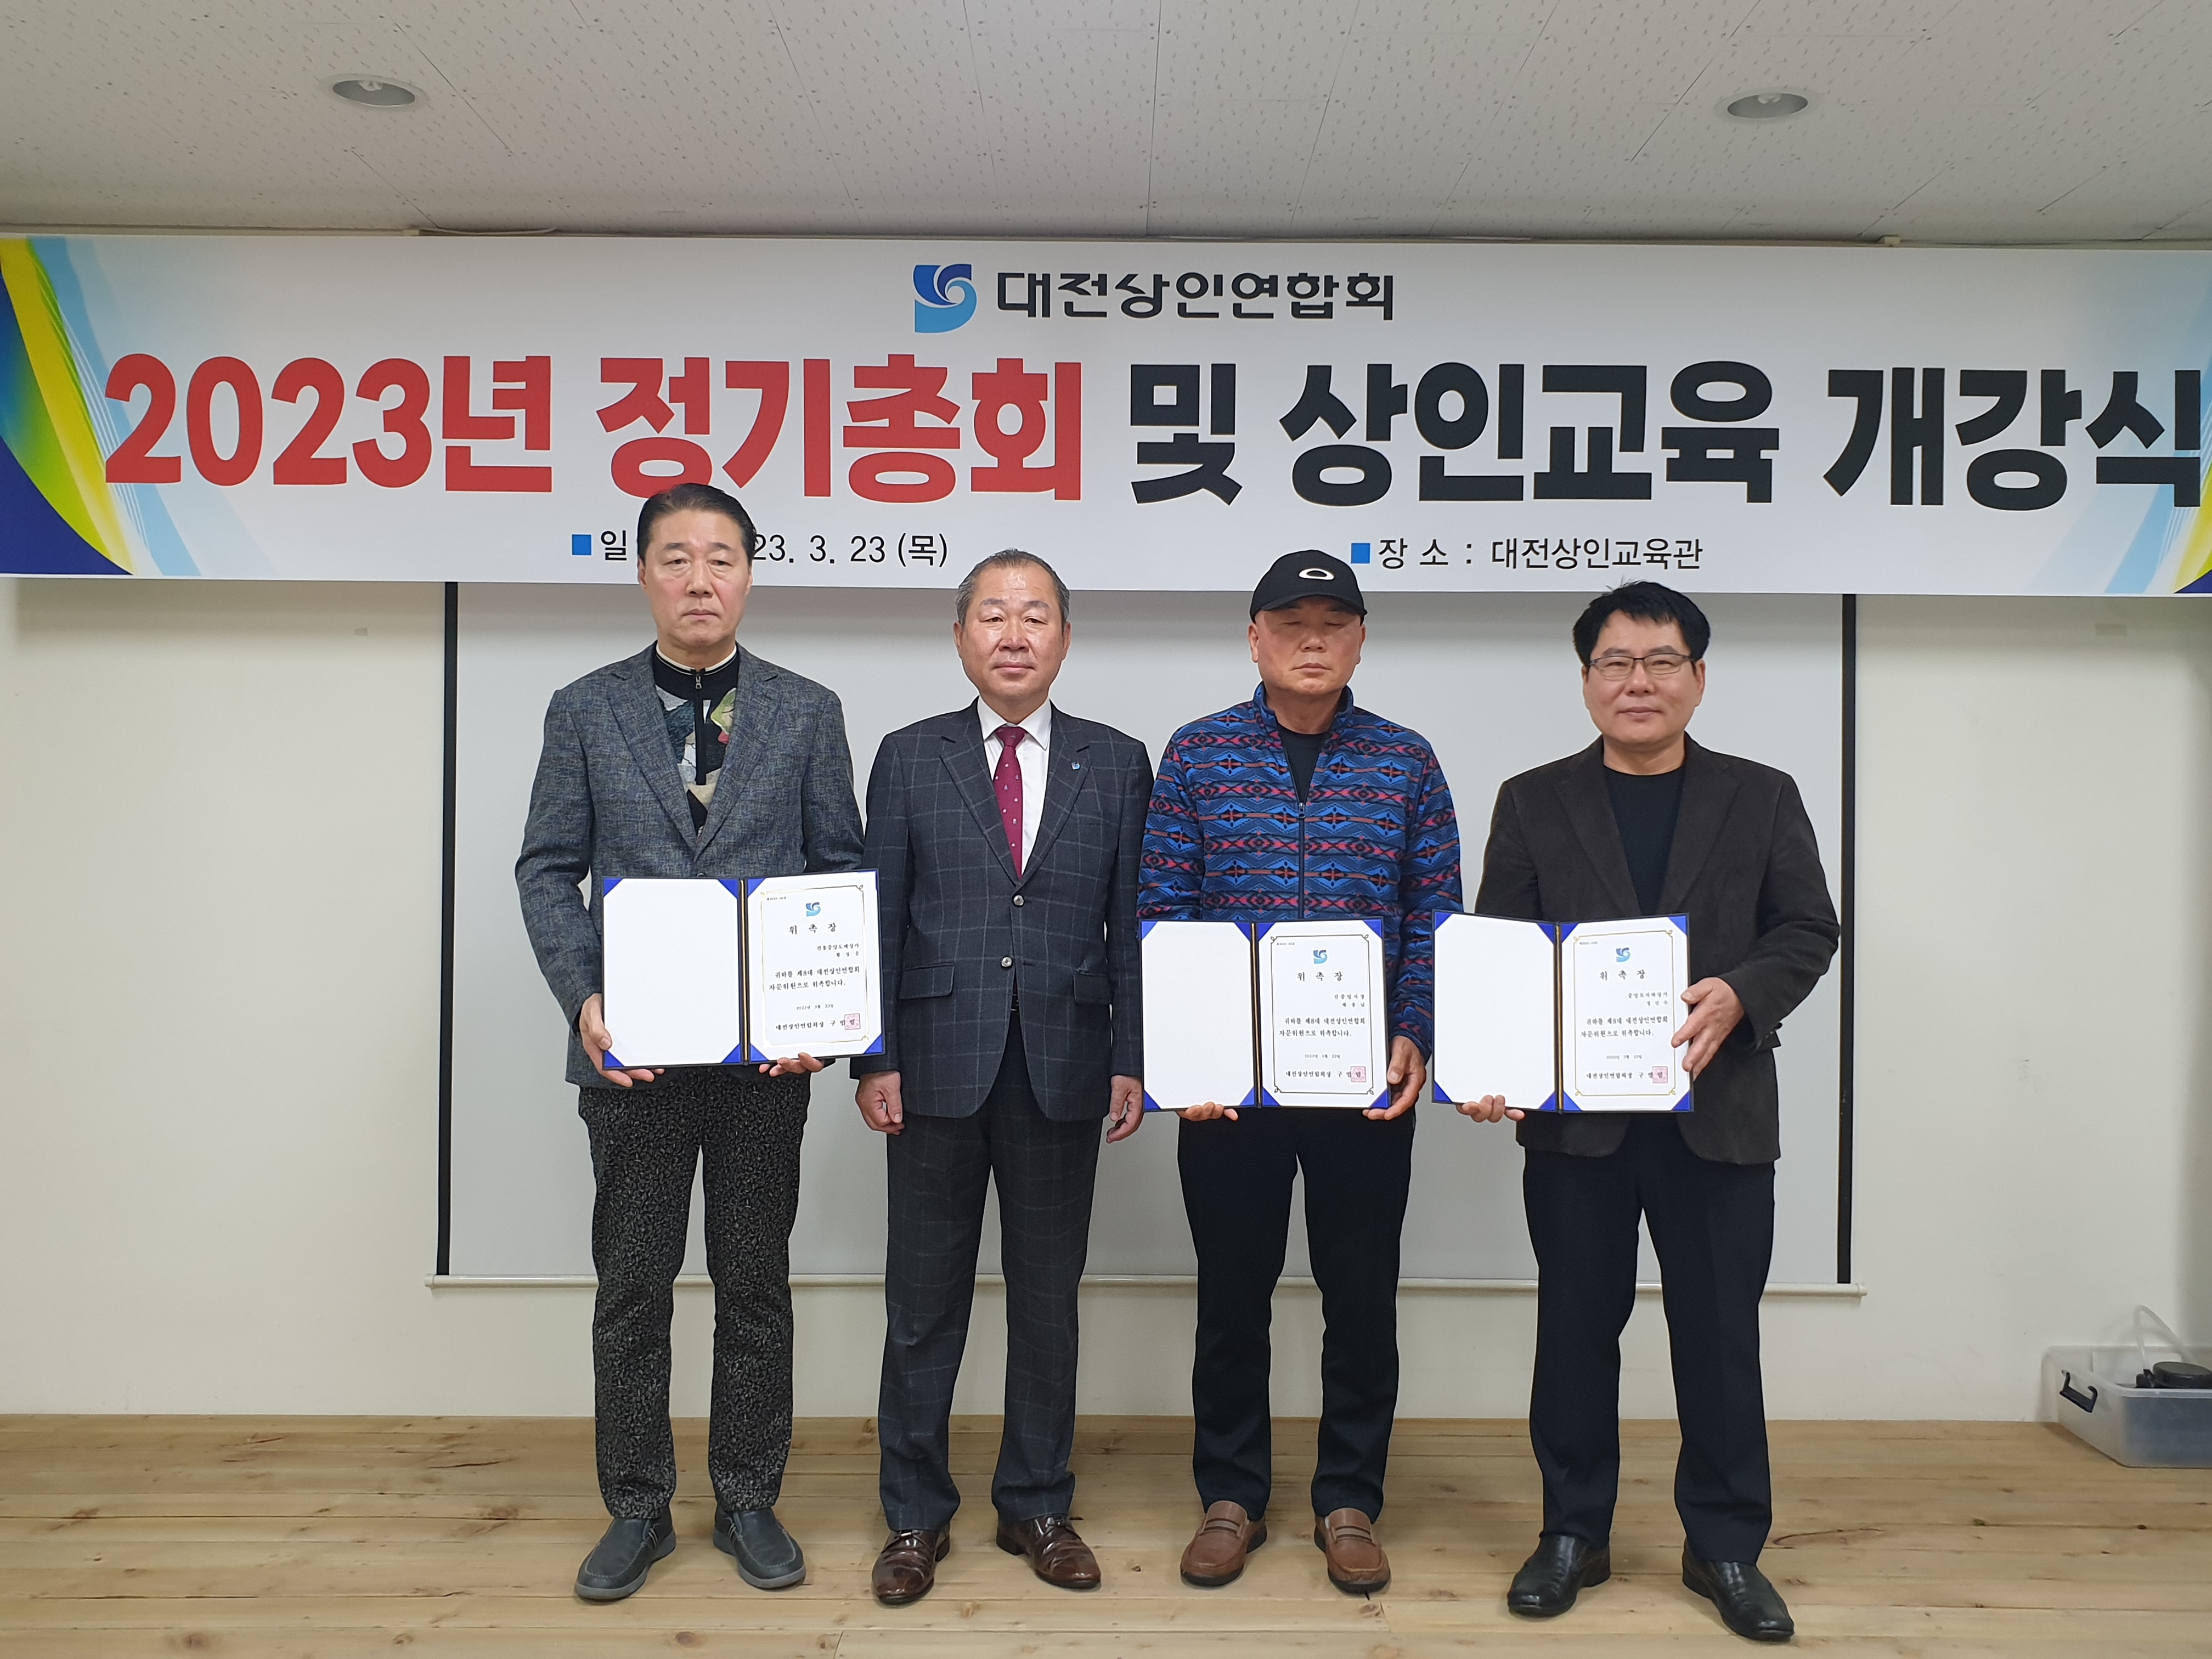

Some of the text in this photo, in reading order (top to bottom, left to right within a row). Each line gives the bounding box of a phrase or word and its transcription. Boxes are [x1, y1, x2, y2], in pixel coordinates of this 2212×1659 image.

[997, 272, 1394, 321] 대전상인연합회
[105, 354, 2202, 512] 2023년 정기총회 및 상인교육 개강식
[600, 531, 947, 568] 일 23. 3. 23 (목)
[1492, 538, 1703, 571] 대전상인교육관
[816, 966, 860, 975] 대전상인연합회
[769, 979, 846, 991] 자문위원으로 위촉합니다.
[1626, 1015, 1668, 1025] 대전상인연합회
[1319, 1029, 1352, 1037] 위촉합니다.
[1581, 1028, 1654, 1039] 자문위원으로 위촉합니다.
